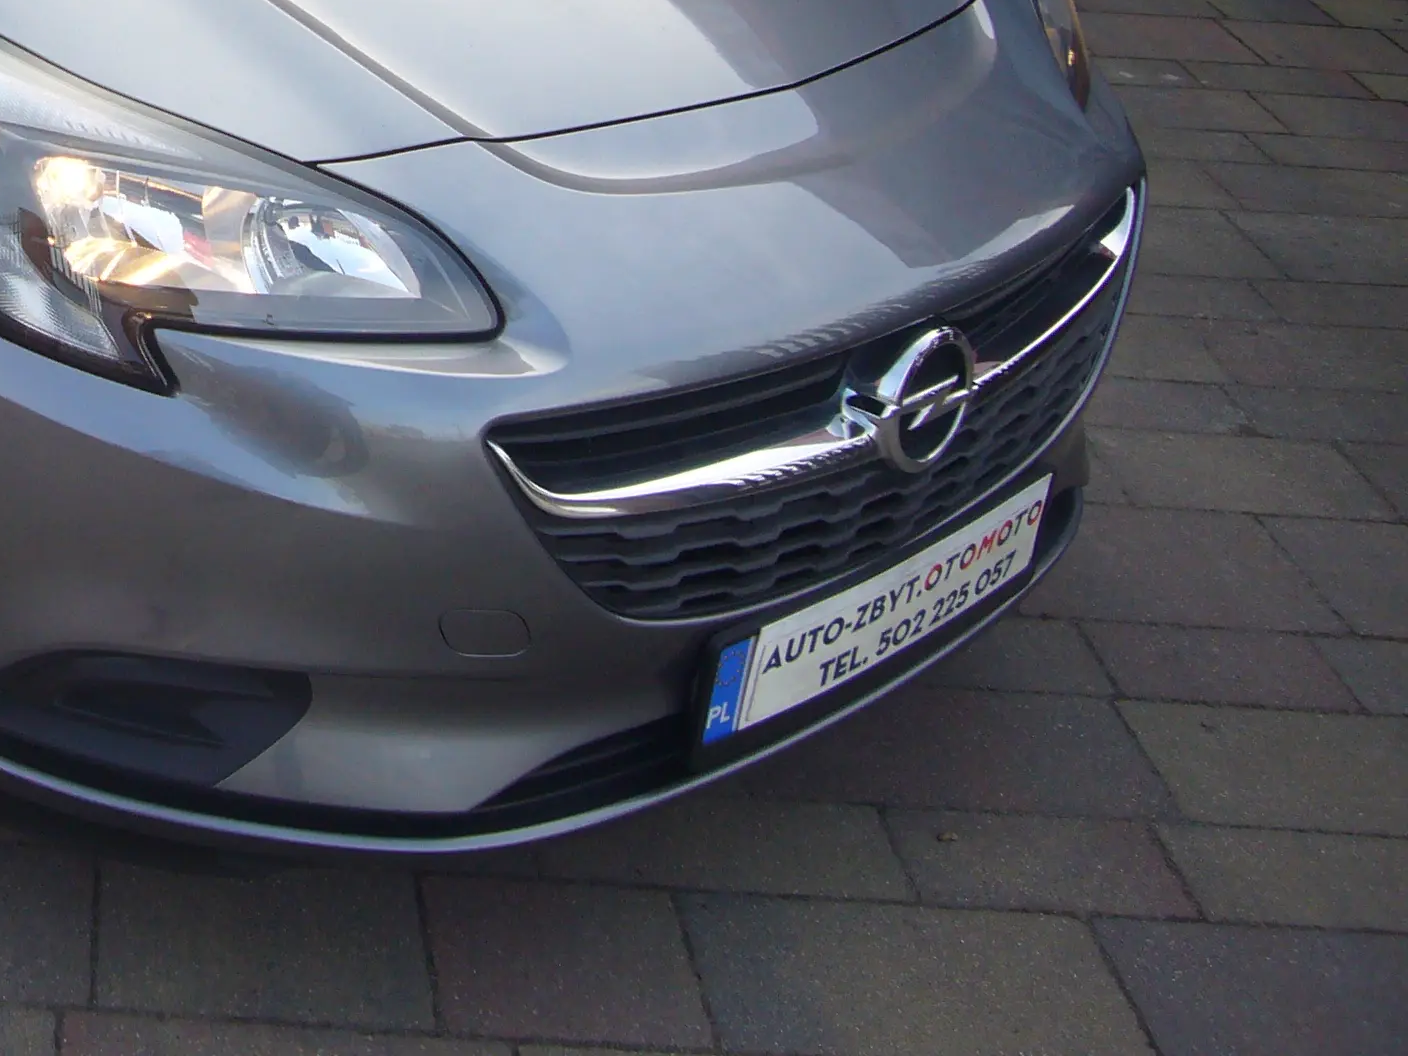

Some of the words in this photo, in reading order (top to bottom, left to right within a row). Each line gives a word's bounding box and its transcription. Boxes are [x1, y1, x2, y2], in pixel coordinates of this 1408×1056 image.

[818, 655, 868, 687] TEL.
[876, 609, 927, 656] 502
[928, 584, 970, 626] 225
[974, 549, 1017, 596] 057
[706, 701, 731, 729] PL
